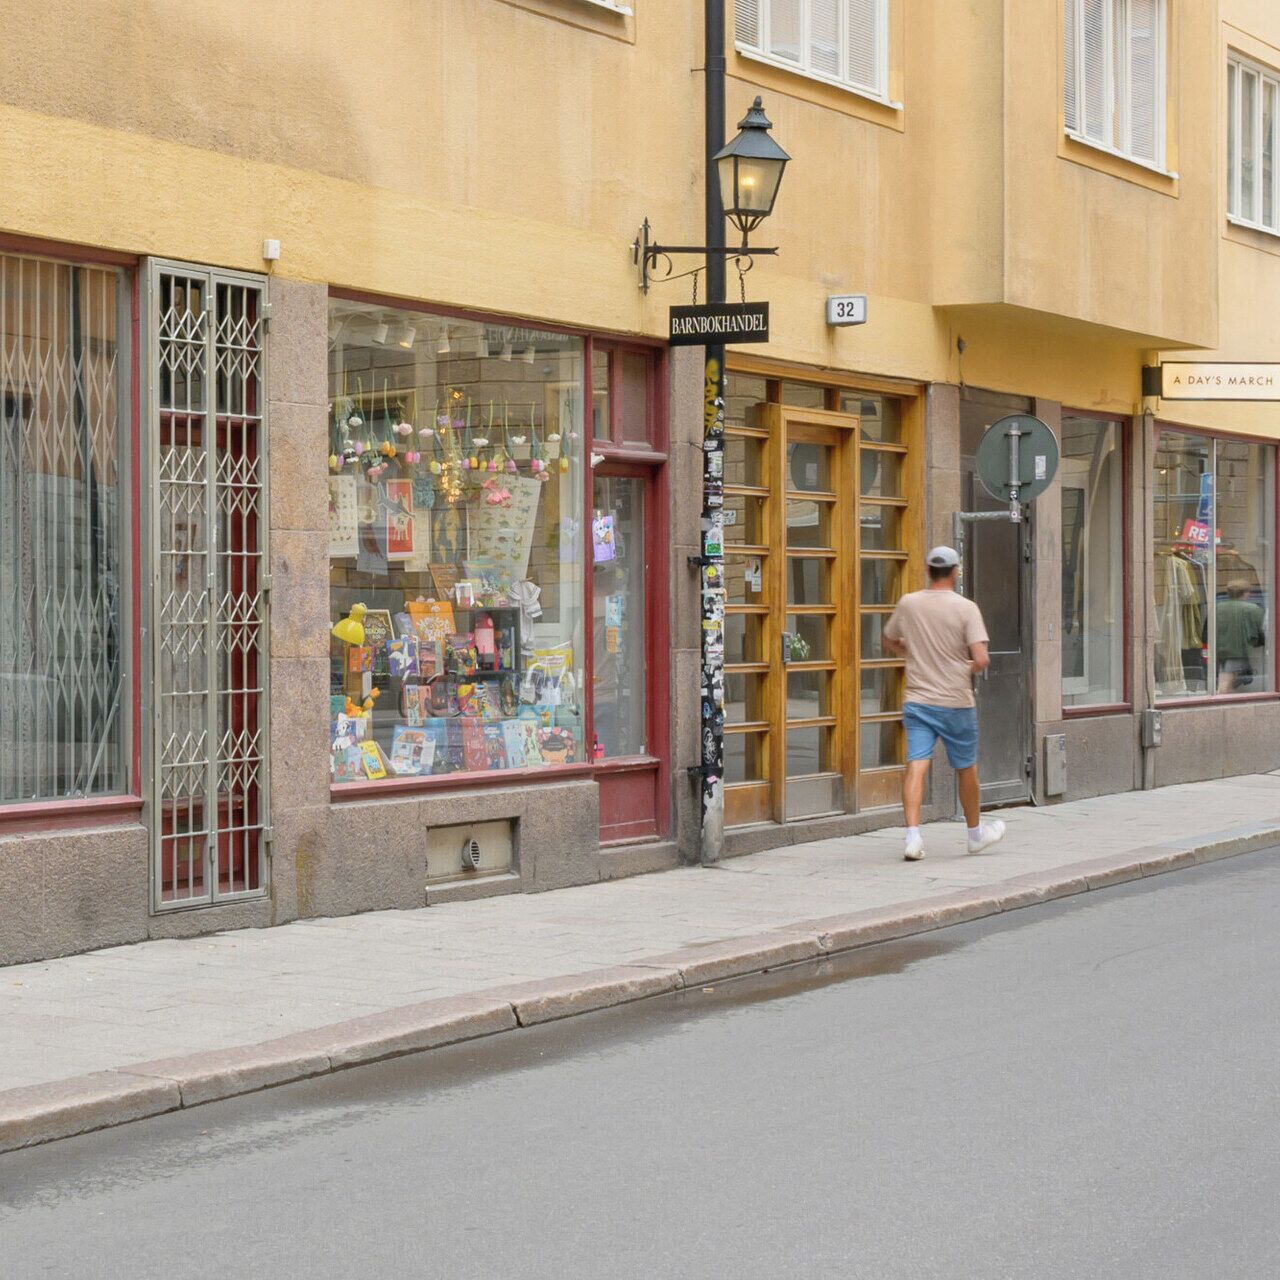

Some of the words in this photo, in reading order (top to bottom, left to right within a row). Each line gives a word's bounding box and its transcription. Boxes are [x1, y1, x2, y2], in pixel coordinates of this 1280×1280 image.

[837, 302, 855, 318] 32
[672, 314, 767, 335] BARNBOKHANDEL
[1173, 376, 1182, 385] A
[1188, 376, 1222, 385] DAY'S
[1228, 376, 1273, 386] MARCH
